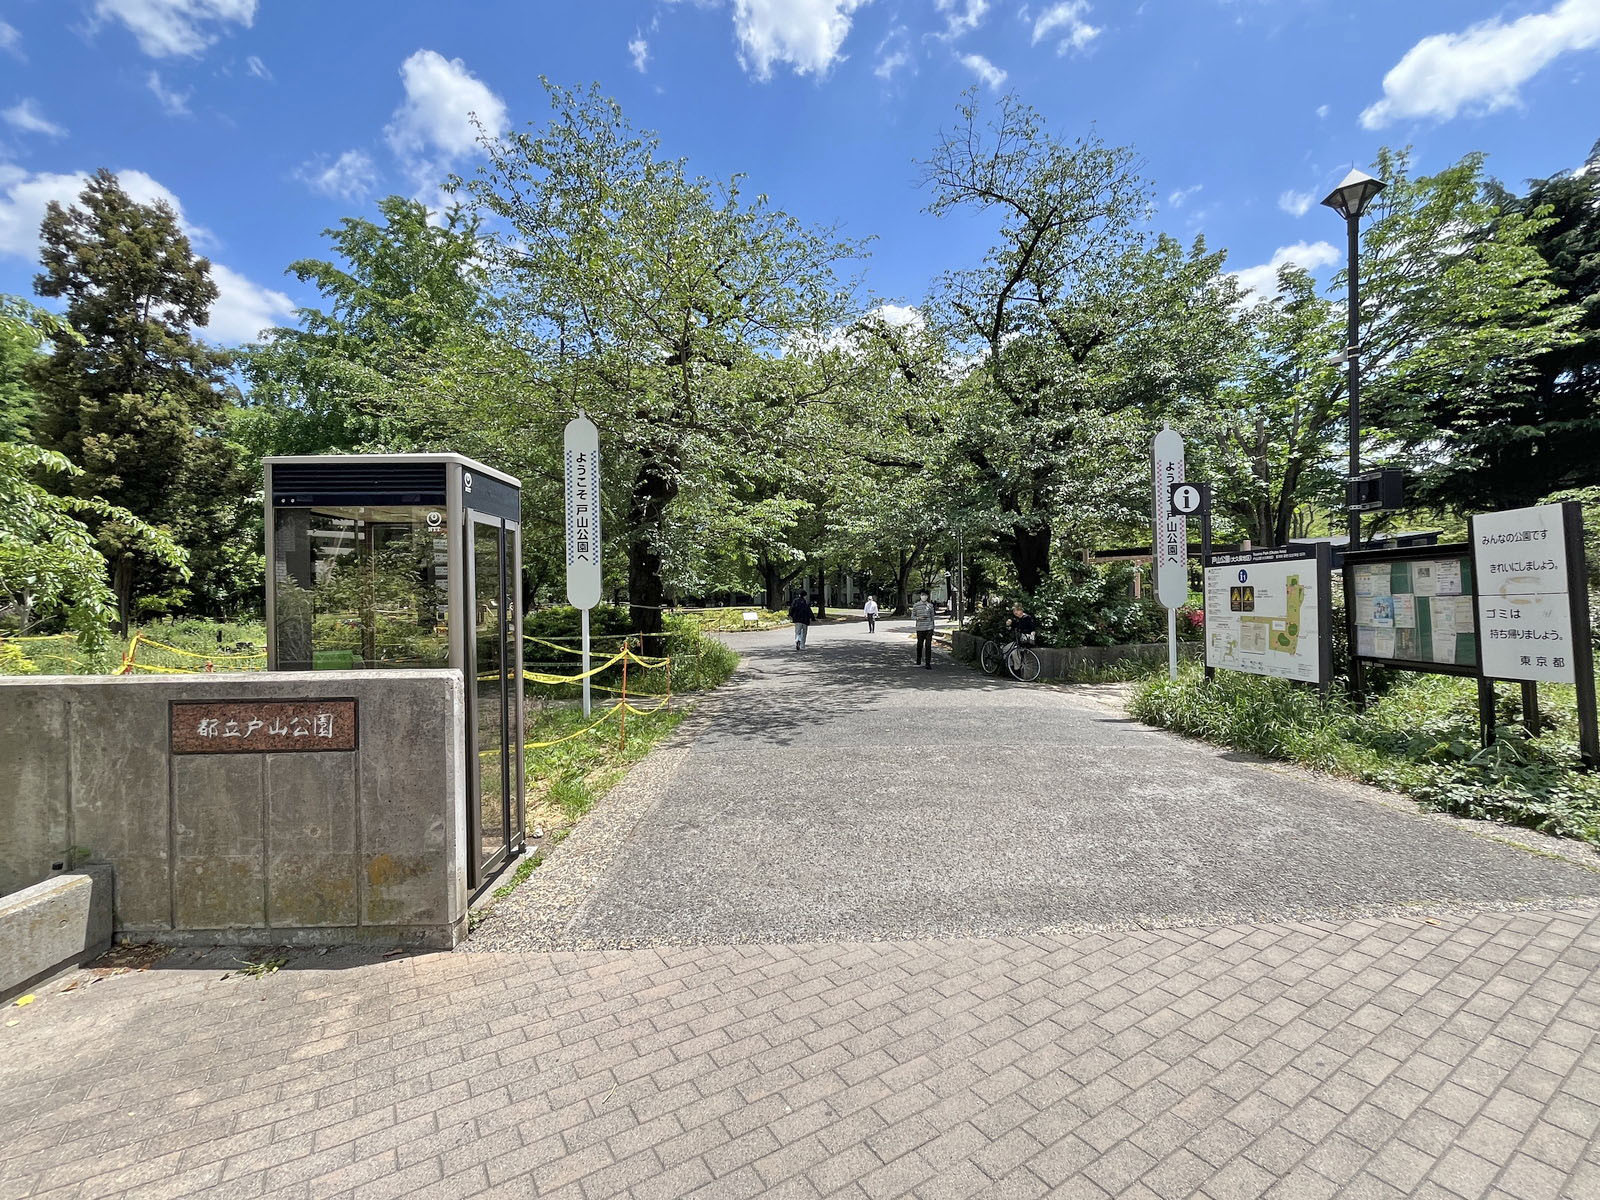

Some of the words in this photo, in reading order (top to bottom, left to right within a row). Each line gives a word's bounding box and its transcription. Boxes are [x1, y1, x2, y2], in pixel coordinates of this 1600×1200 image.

[576, 452, 589, 562] ようこそ戸山公園へ
[1481, 529, 1549, 545] みんなの公園です
[1489, 559, 1559, 574] きれいにしましょう。
[1486, 608, 1521, 619] ゴミは
[1490, 628, 1563, 641] 持ち帰りましょう。
[1520, 655, 1565, 668] 東京都
